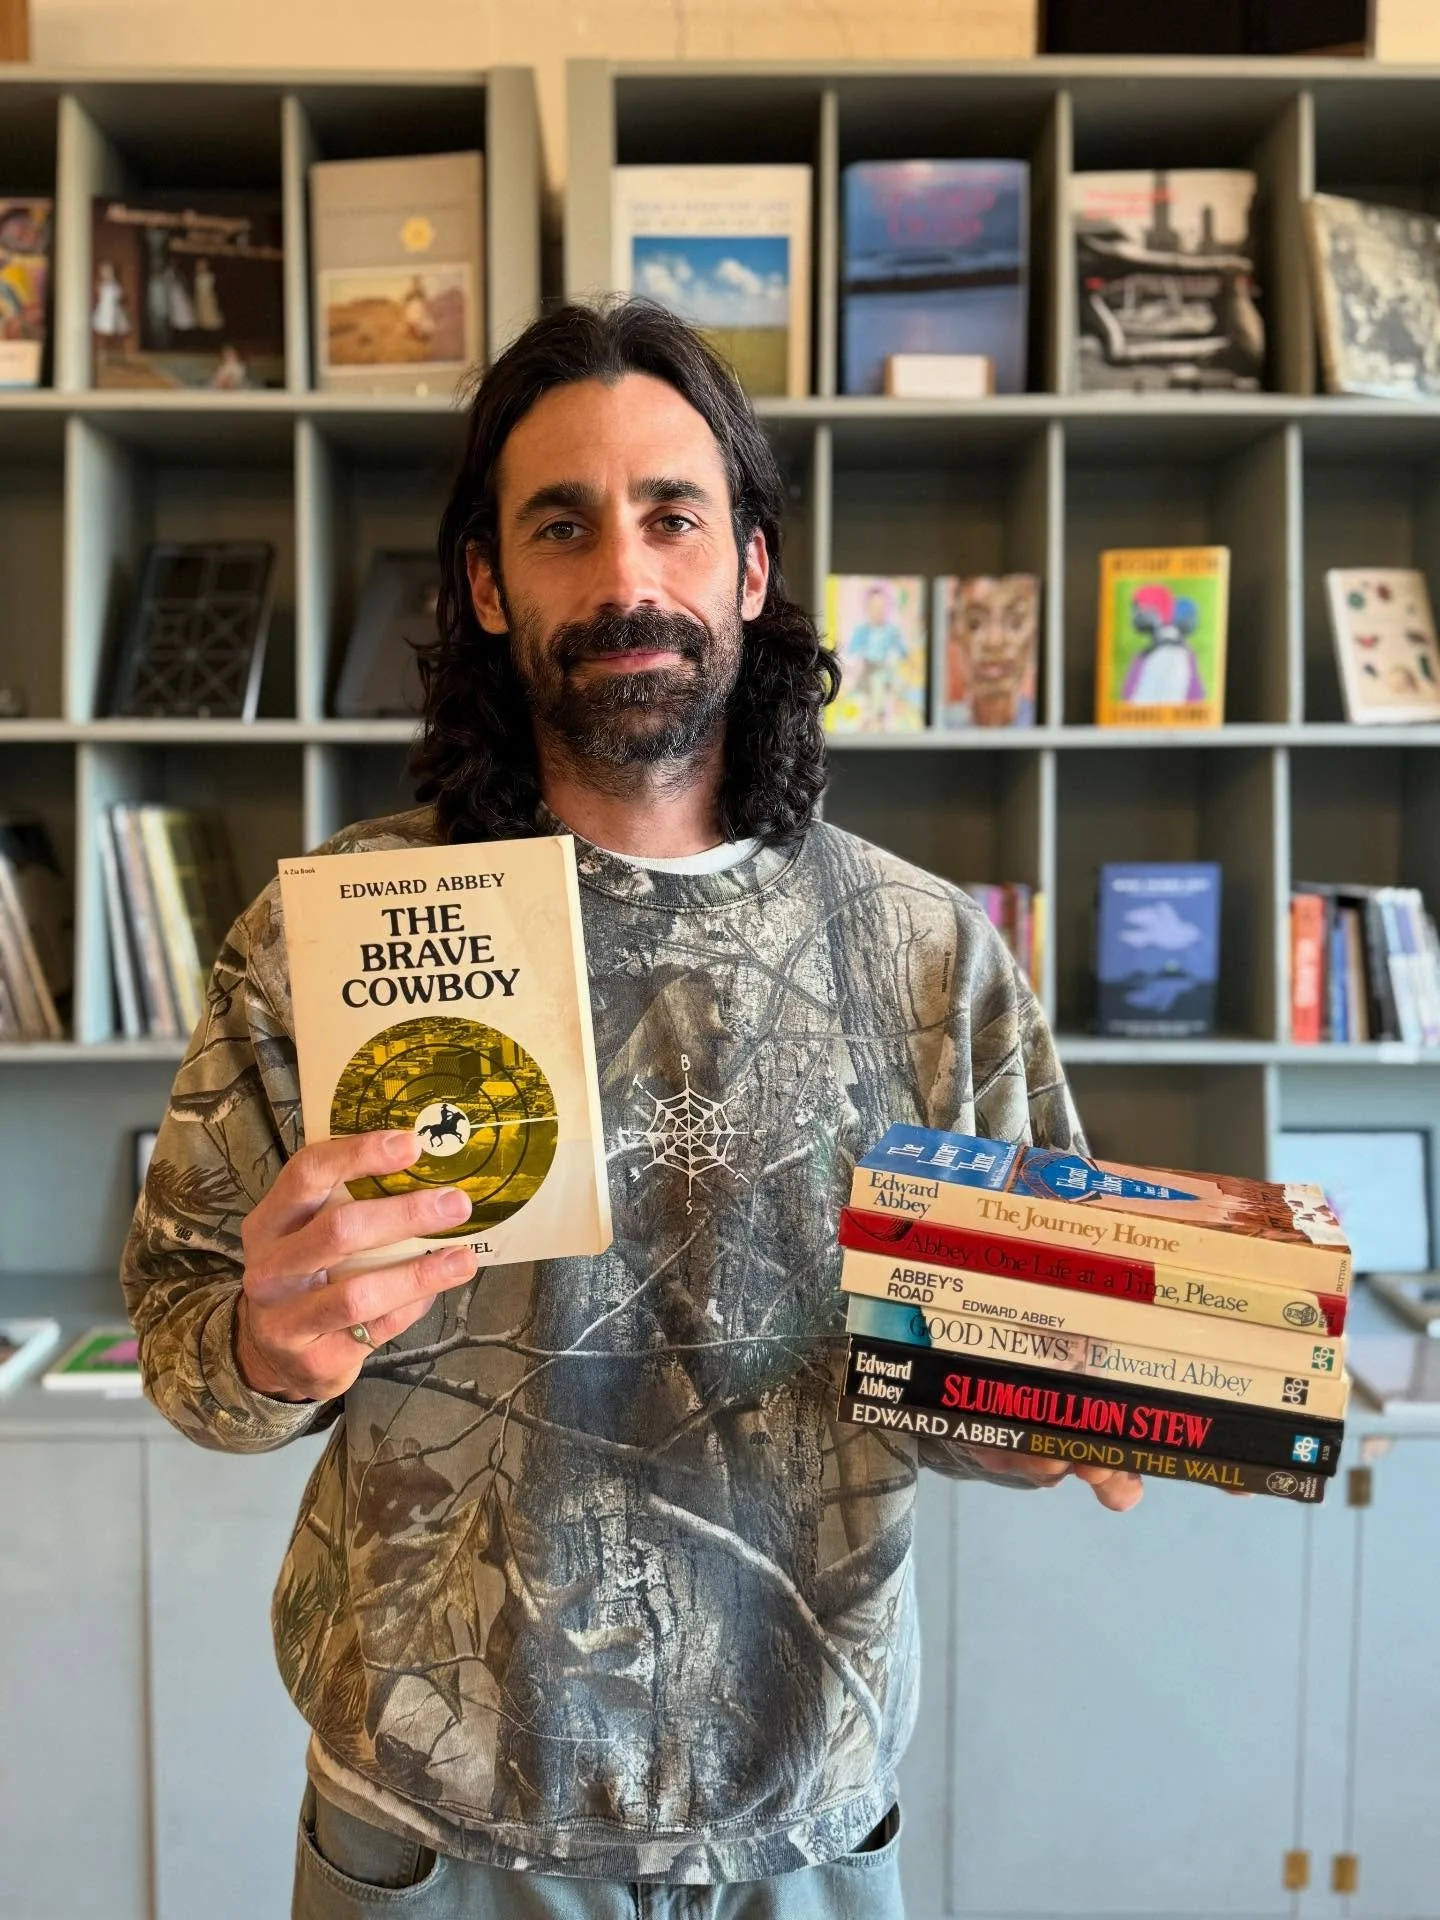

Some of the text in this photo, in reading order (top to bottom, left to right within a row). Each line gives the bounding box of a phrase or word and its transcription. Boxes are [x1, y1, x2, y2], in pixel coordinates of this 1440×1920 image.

[339, 872, 505, 899] EDWARD ABBEY
[381, 903, 465, 936] THE
[360, 935, 495, 972] BRAVE
[342, 968, 520, 1008] COWBOY
[869, 1171, 939, 1199] Edward
[873, 1190, 931, 1219] Abbey
[977, 1197, 1180, 1252] The Journey Home
[890, 1267, 964, 1293] ABBEY'S
[905, 1232, 1249, 1313] Abbey One Life at a Time, Please
[1335, 1259, 1347, 1293] DUTTON
[887, 1283, 934, 1303] ROAD
[962, 1299, 1066, 1329] EDWARD ABBEY
[909, 1314, 1070, 1362] GOOD NEWS
[855, 1351, 913, 1380] Edward
[1089, 1343, 1253, 1397] Edward Abbey
[858, 1376, 905, 1405] Abbey
[941, 1373, 1213, 1449] SLUMGULLION STEW
[852, 1403, 1245, 1487] EDWARD ABBEY BEYOND THE WALL
